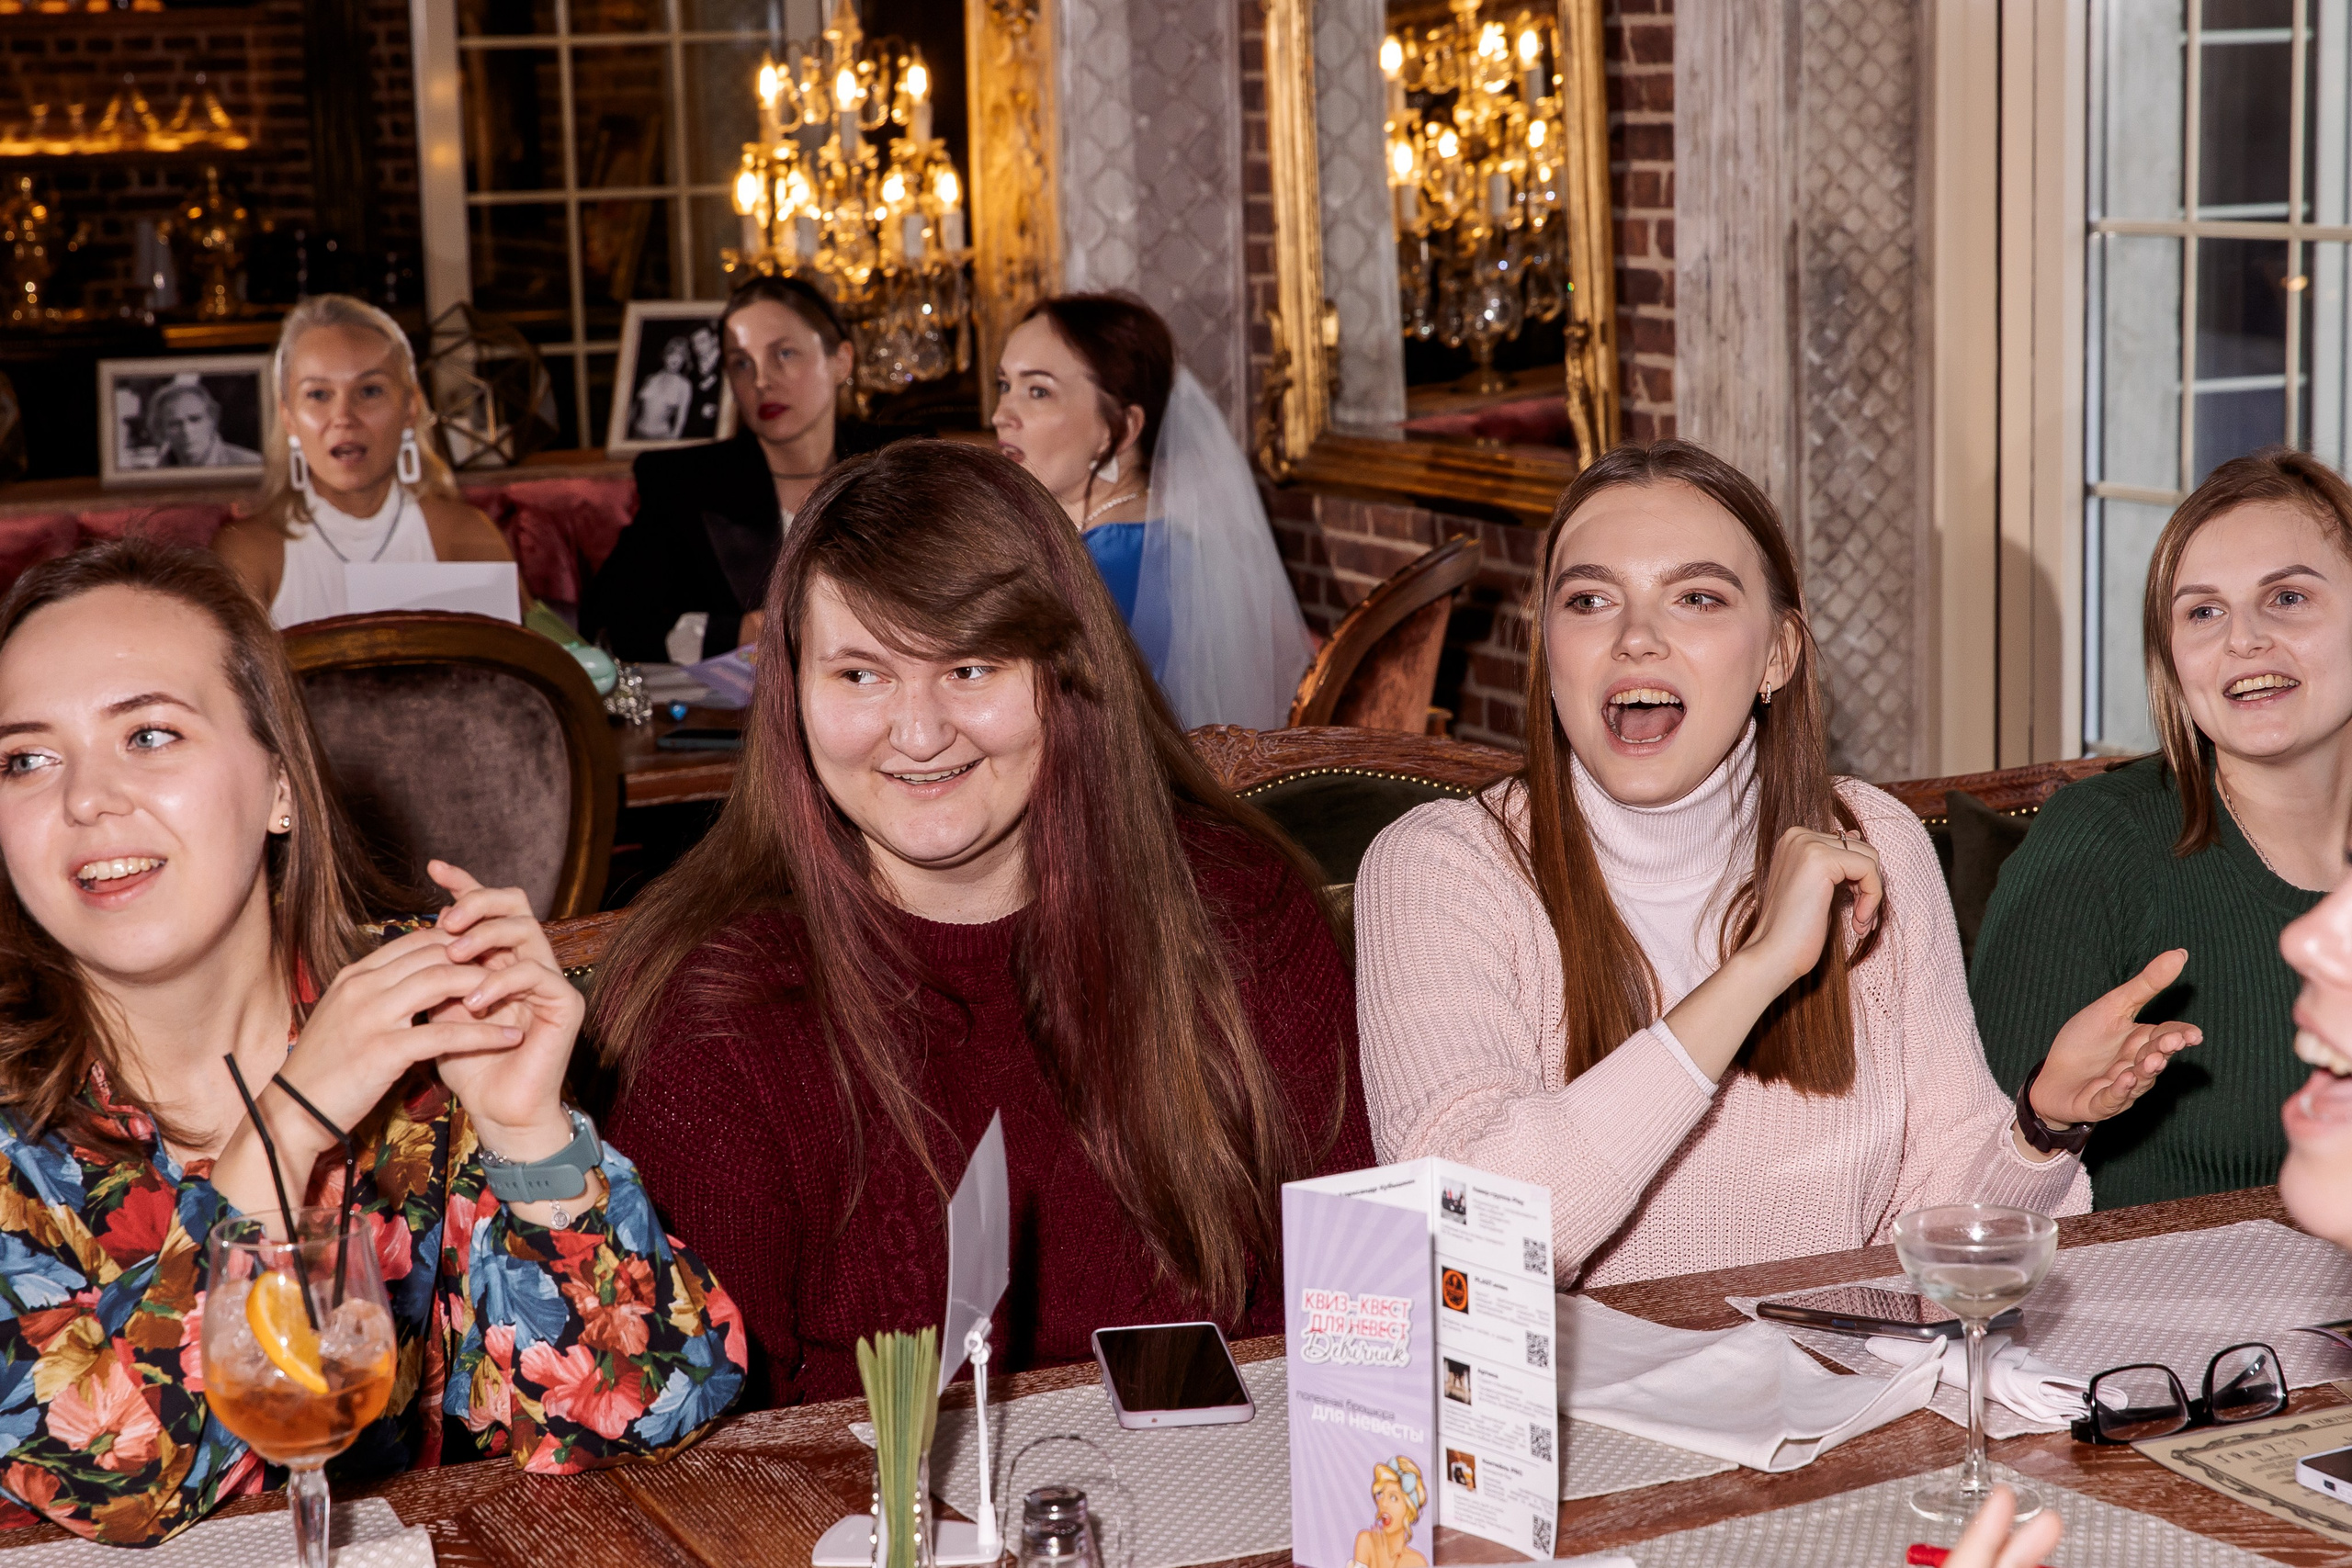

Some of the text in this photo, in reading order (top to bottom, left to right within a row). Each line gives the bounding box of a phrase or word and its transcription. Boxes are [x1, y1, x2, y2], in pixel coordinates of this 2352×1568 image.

[1310, 1314, 1408, 1340] ДЛЯ НЕВЕСТ
[1304, 1329, 1406, 1361] Девичник
[1311, 1404, 1346, 1426] для
[1348, 1412, 1424, 1444] невесты
